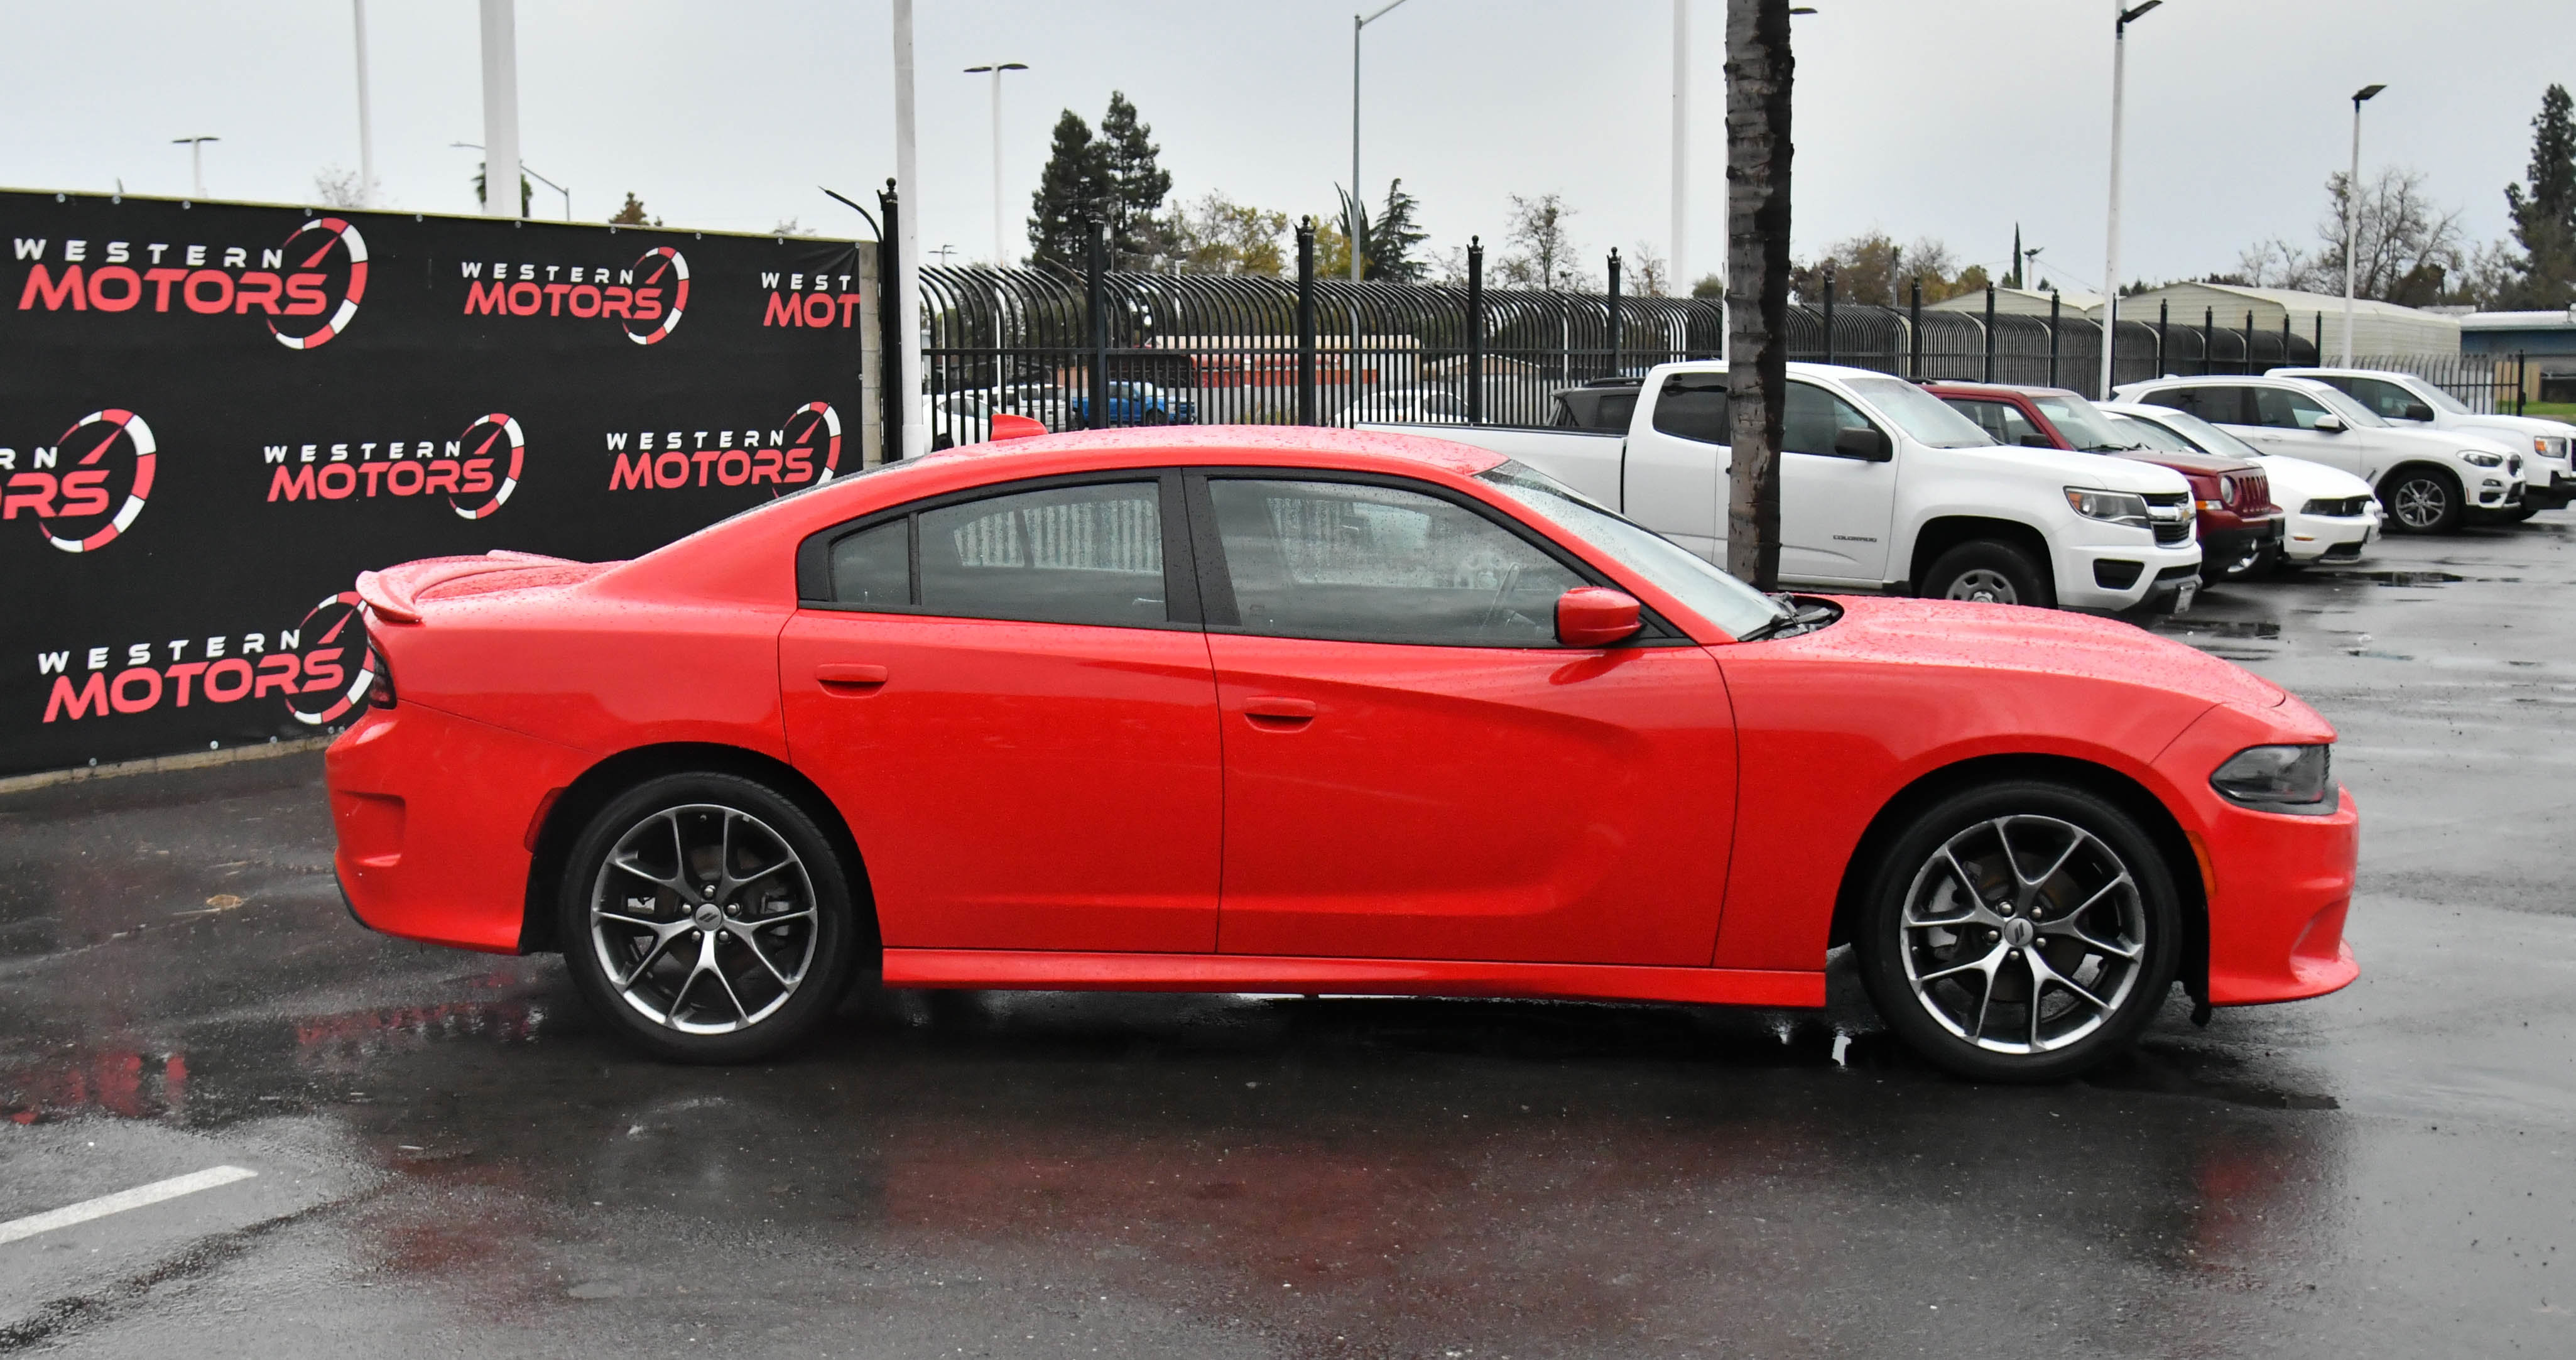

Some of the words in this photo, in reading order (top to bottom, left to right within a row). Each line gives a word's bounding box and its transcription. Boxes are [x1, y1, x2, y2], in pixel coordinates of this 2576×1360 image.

[14, 238, 283, 269] WESTERN
[18, 263, 327, 315] MOTORS
[462, 262, 633, 285] WESTERN
[761, 272, 851, 291] WEST
[464, 281, 662, 320] MOTORS
[763, 291, 860, 328] MOT
[264, 440, 460, 464] WESTERN
[606, 430, 784, 451] WESTERN
[267, 458, 494, 502] MOTORS
[609, 447, 813, 491] MOTORS
[0, 470, 110, 520] RS
[38, 629, 300, 675] WESTERN
[43, 647, 344, 723] MOTORS
